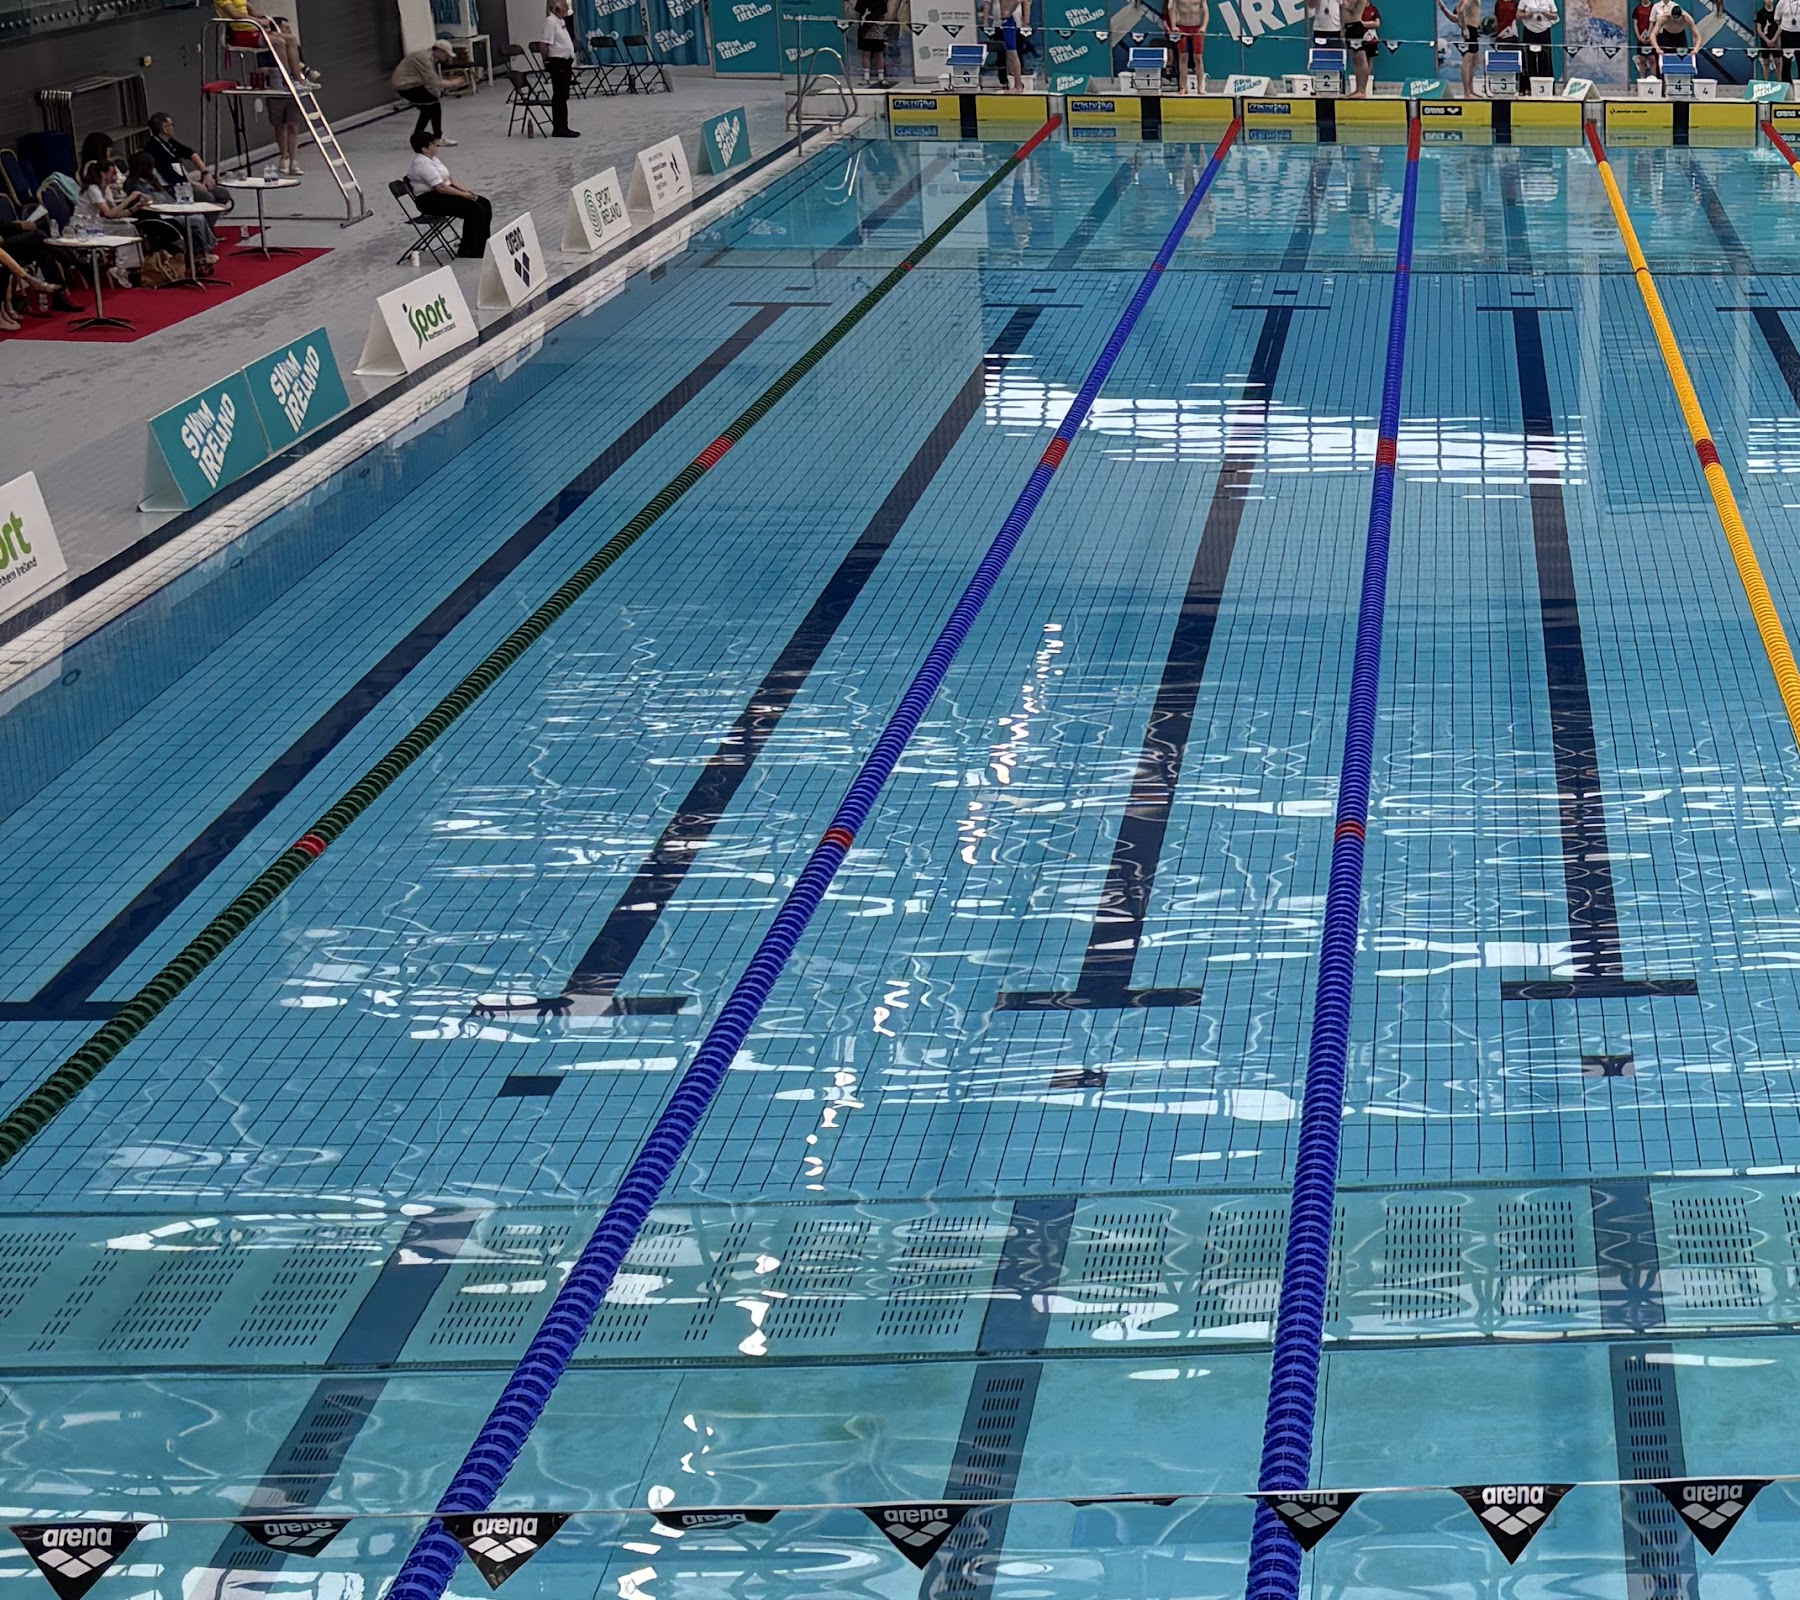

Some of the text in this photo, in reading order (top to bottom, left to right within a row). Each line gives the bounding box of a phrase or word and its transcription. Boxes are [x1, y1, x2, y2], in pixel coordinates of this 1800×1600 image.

[1302, 83, 1309, 92] 2
[1539, 85, 1545, 94] 3
[1647, 87, 1654, 96] 4
[1674, 80, 1682, 92] 4
[1702, 87, 1709, 95] 4
[595, 186, 612, 209] SPORT
[505, 226, 526, 256] arena
[270, 350, 302, 406] SWIM
[284, 345, 320, 434] IRELAND
[181, 398, 216, 459] SWIM
[198, 392, 236, 489] IRELAND
[1481, 1485, 1544, 1505] arena
[1682, 1483, 1744, 1502] arena
[682, 1513, 747, 1525] arena
[883, 1507, 949, 1524] arena
[263, 1519, 333, 1536] arena
[472, 1516, 538, 1537] arena
[42, 1527, 113, 1548] arena
